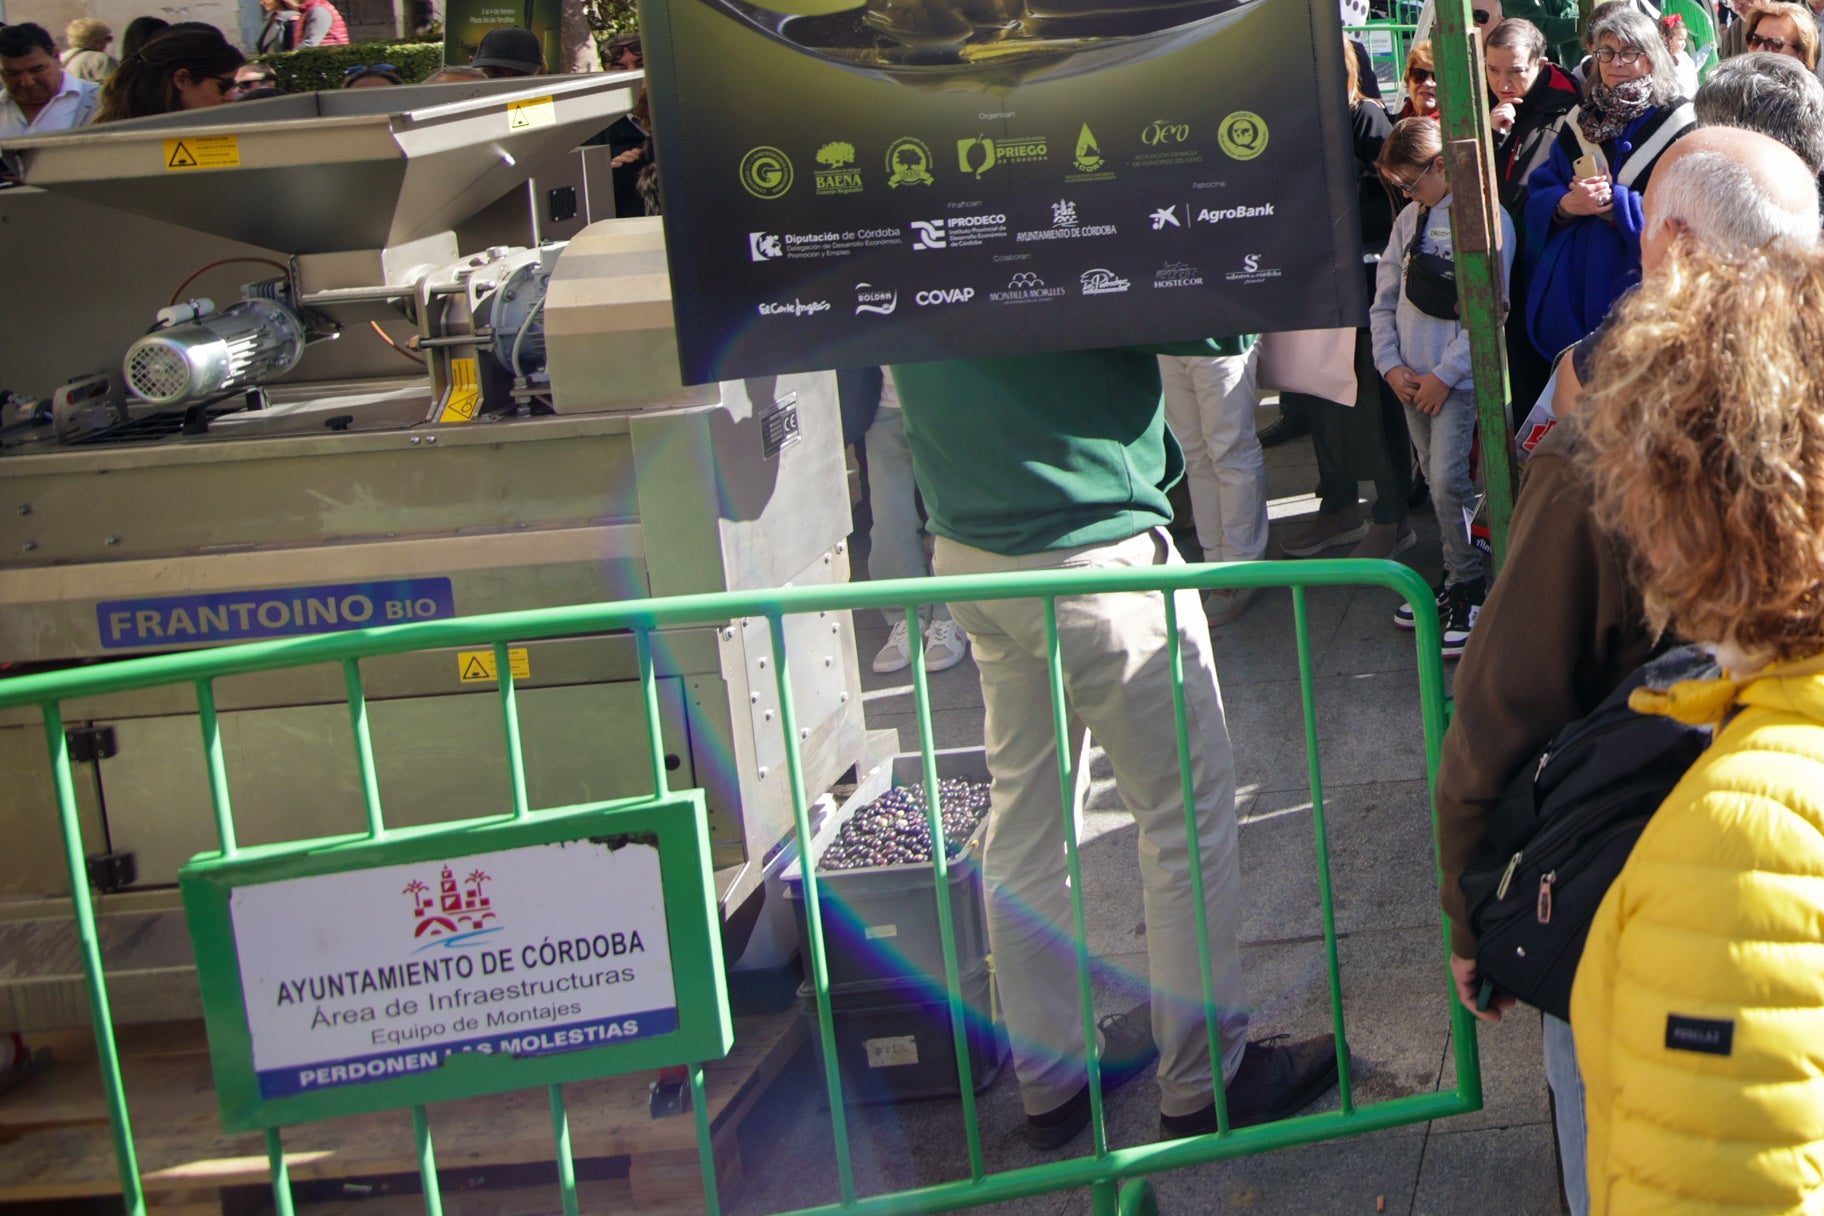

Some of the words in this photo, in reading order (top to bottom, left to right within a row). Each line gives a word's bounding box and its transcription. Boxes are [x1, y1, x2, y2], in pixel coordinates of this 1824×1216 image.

[997, 145, 1048, 158] PRIEGO
[816, 174, 863, 189] BAENA
[947, 214, 1006, 227] IPRODECO
[1197, 203, 1275, 223] AgroBank
[785, 232, 840, 245] Diputación
[842, 231, 856, 240] de
[858, 227, 901, 240] Córdoba
[1016, 228, 1070, 242] AYUNTAMIENTO
[1072, 227, 1081, 238] DE
[1082, 225, 1117, 237] CÓRDOBA
[1154, 277, 1203, 289] HOSTECOR
[916, 287, 975, 305] COVAP
[109, 594, 374, 640] FRANTOINO
[385, 598, 437, 620] BIO
[276, 955, 474, 1007] AYUNTAMIENTO
[482, 946, 514, 975] DE
[521, 929, 645, 970] CÓRDOBA
[311, 1003, 376, 1031] Área
[385, 996, 419, 1020] de
[429, 964, 636, 1013] Infraestructuras
[371, 1018, 446, 1048] Equipo
[453, 1014, 479, 1036] de
[486, 1000, 582, 1032] Montajes
[300, 1050, 439, 1087] PERDONEN
[500, 1019, 640, 1056] MOLESTIAS
